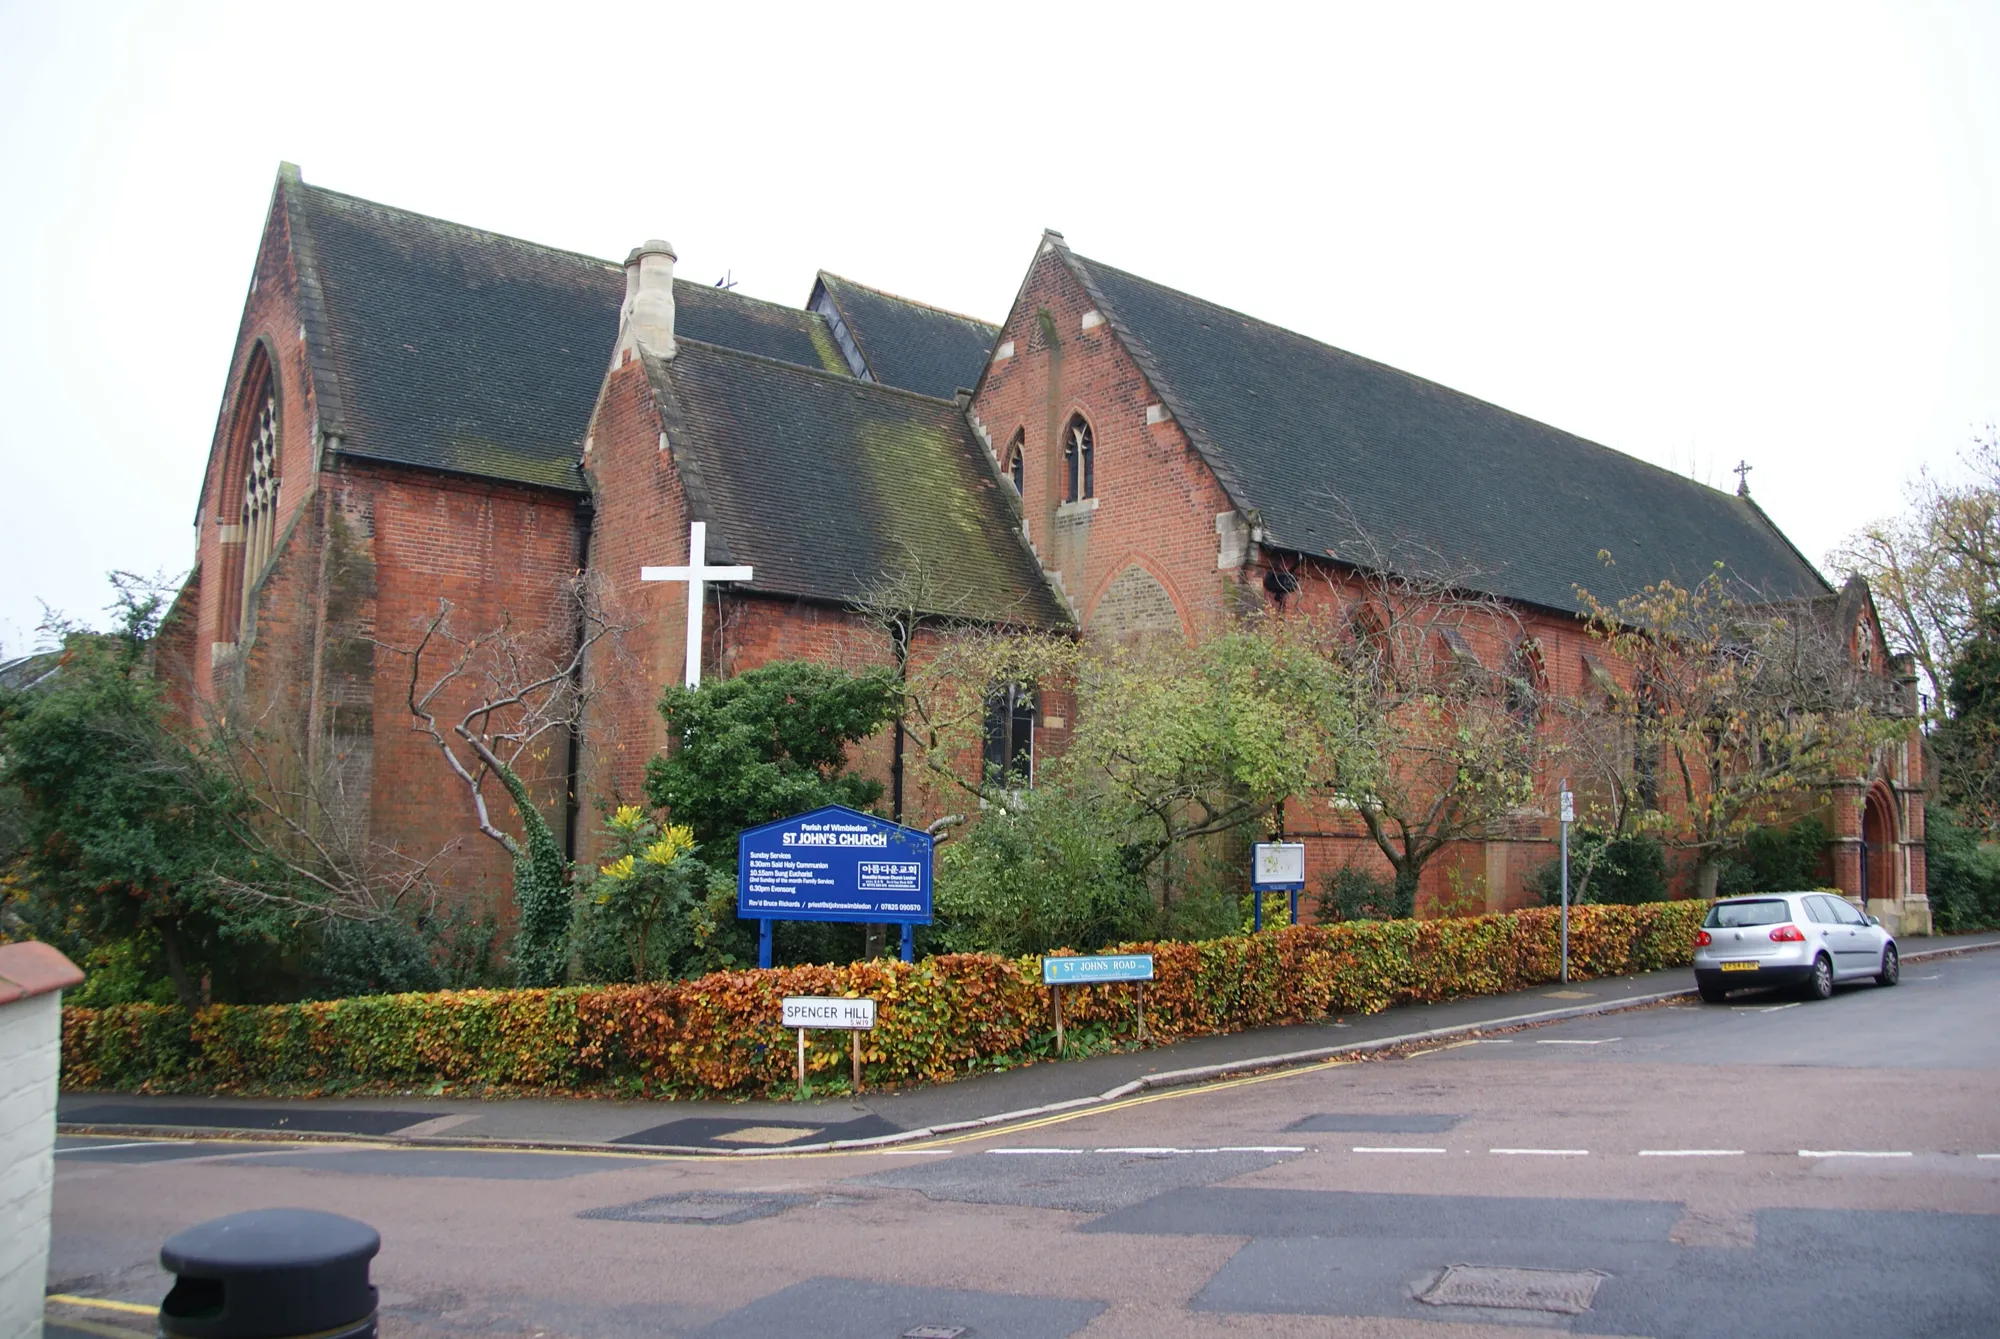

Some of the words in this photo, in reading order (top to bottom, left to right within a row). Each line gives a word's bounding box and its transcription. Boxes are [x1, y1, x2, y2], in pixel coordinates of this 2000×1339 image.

[831, 824, 868, 832] Wimbledon
[783, 833, 797, 844] ST
[798, 833, 837, 845] JOHN'S
[839, 833, 887, 845] CHURCH
[750, 852, 769, 860] Sunday
[749, 885, 770, 893] 6.30pm
[771, 886, 796, 894] Evensong
[1064, 962, 1075, 972] ST
[1114, 961, 1136, 970] ROAD
[787, 1005, 838, 1018] SPENCER
[844, 1007, 869, 1019] HILL
